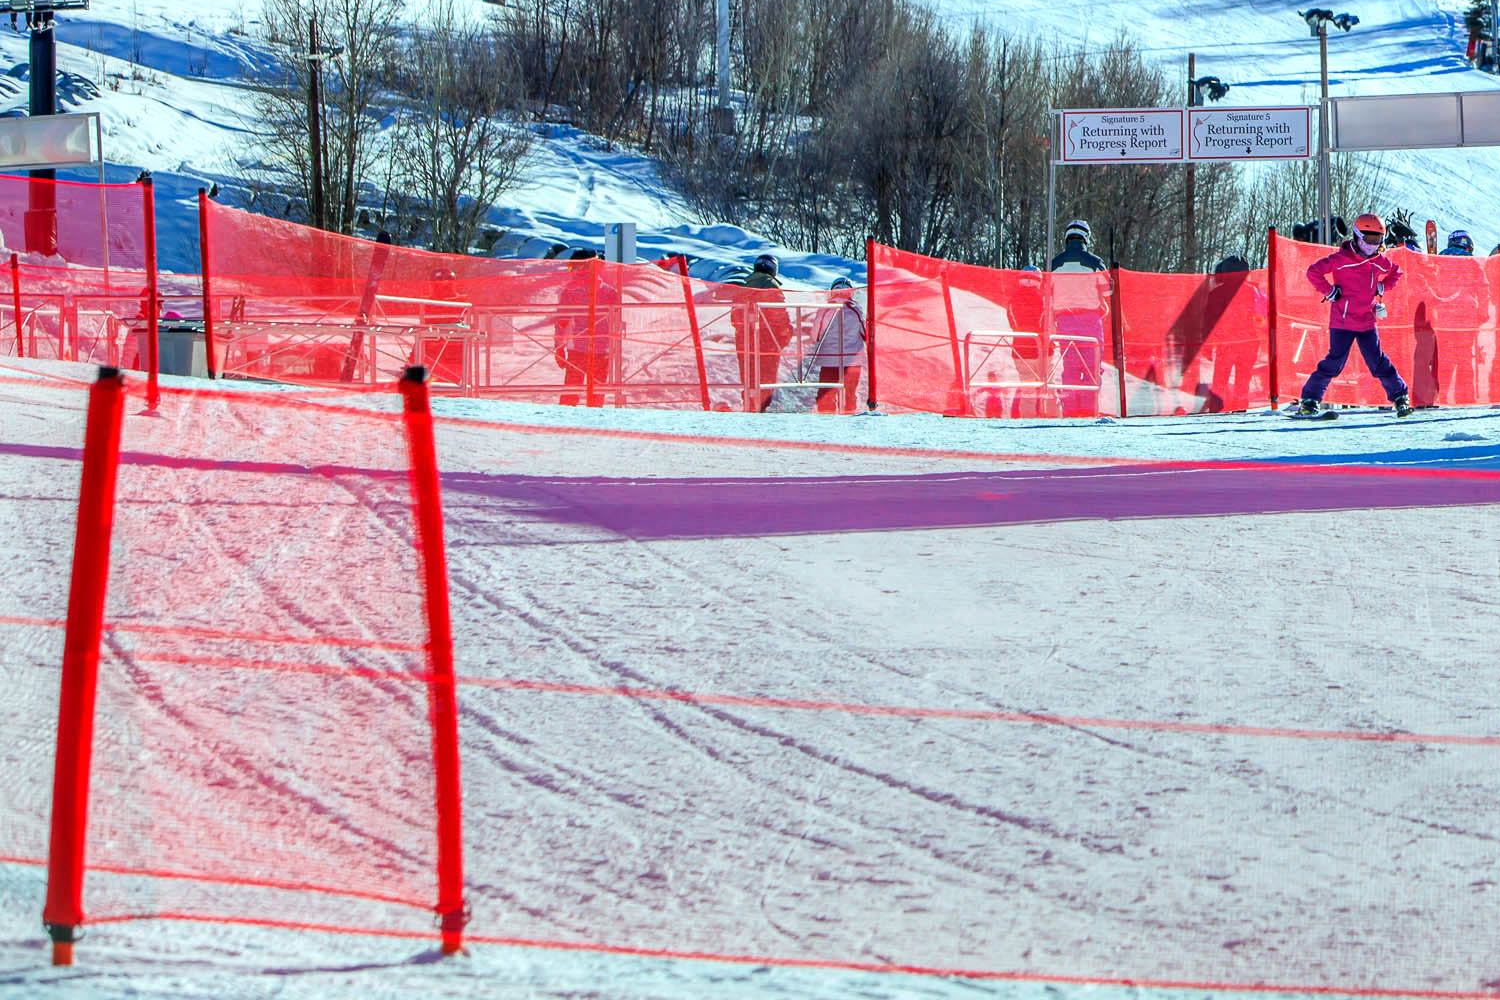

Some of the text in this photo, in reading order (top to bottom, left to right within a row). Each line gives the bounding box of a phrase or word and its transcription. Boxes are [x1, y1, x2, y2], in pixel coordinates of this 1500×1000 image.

[1101, 115, 1145, 124] Signature 5
[1226, 113, 1271, 122] Signature 5
[1082, 125, 1165, 138] Returning with
[1207, 122, 1290, 136] Returning with
[1080, 137, 1167, 151] Progress Report
[1205, 134, 1293, 148] Progress Report
